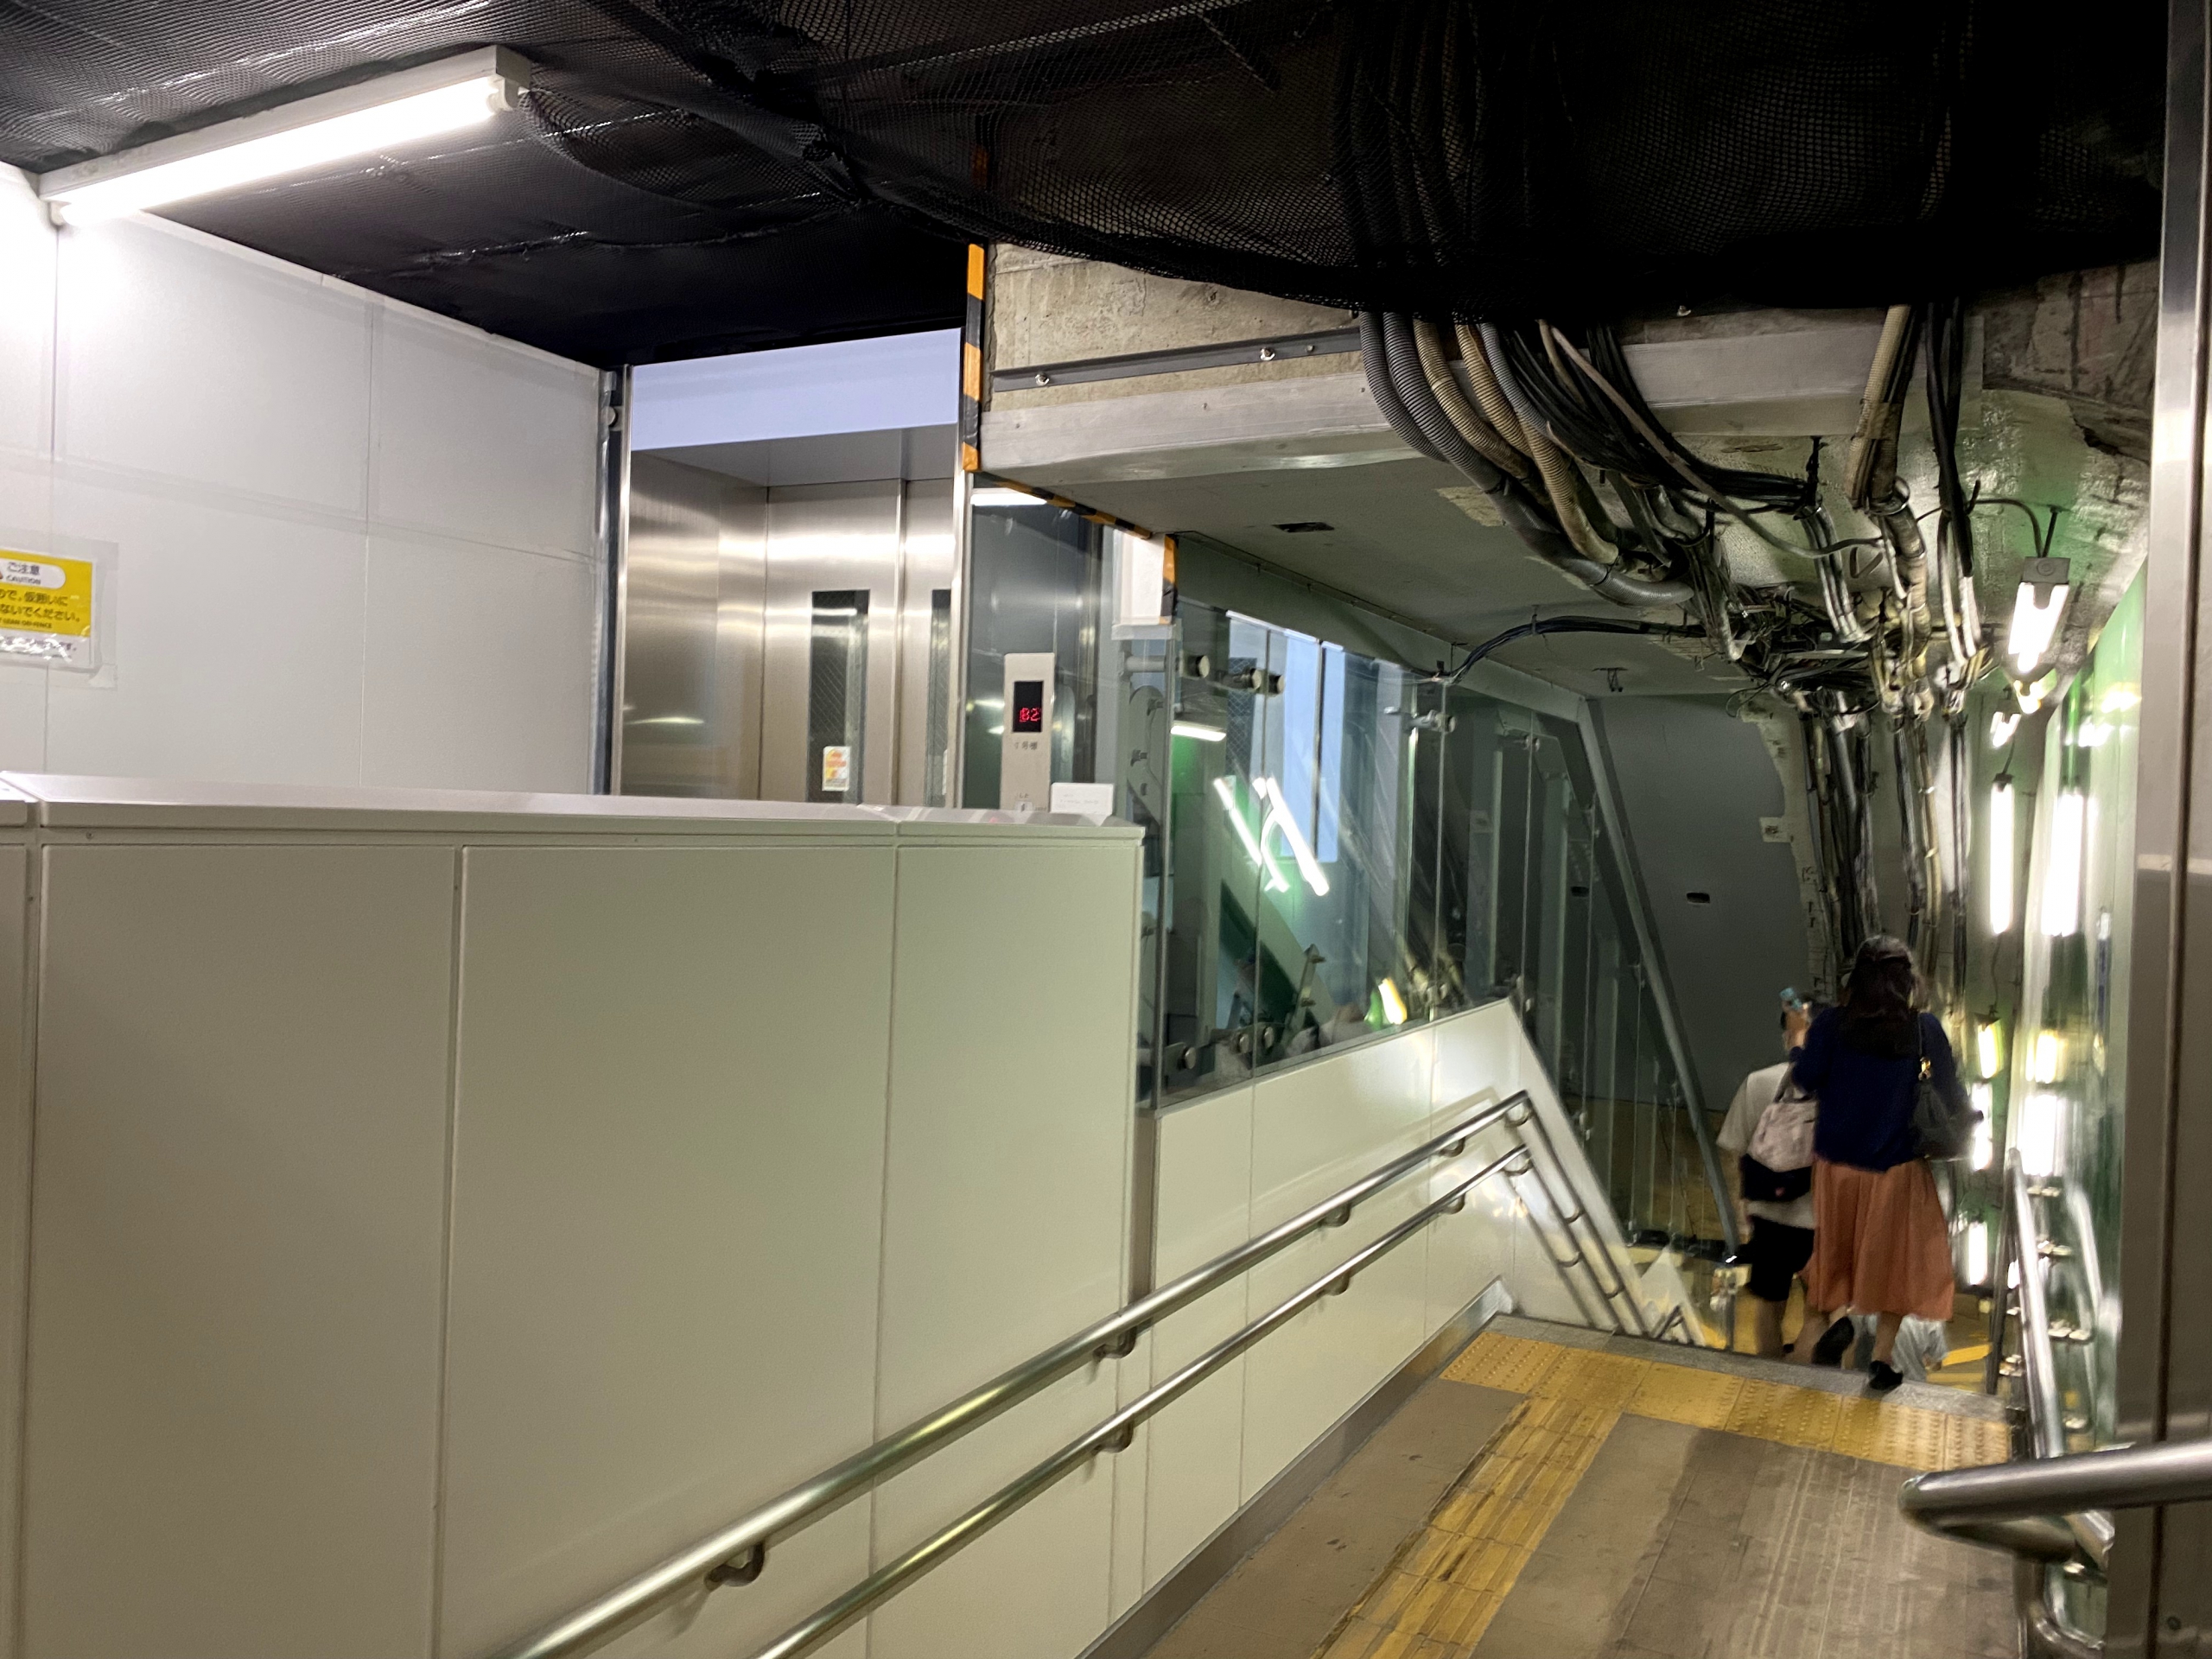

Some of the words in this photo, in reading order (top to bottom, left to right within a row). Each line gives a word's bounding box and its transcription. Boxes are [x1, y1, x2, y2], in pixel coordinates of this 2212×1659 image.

[7, 562, 40, 575] ご注意
[6, 575, 41, 585] CAUTION
[1019, 707, 1040, 722] B2
